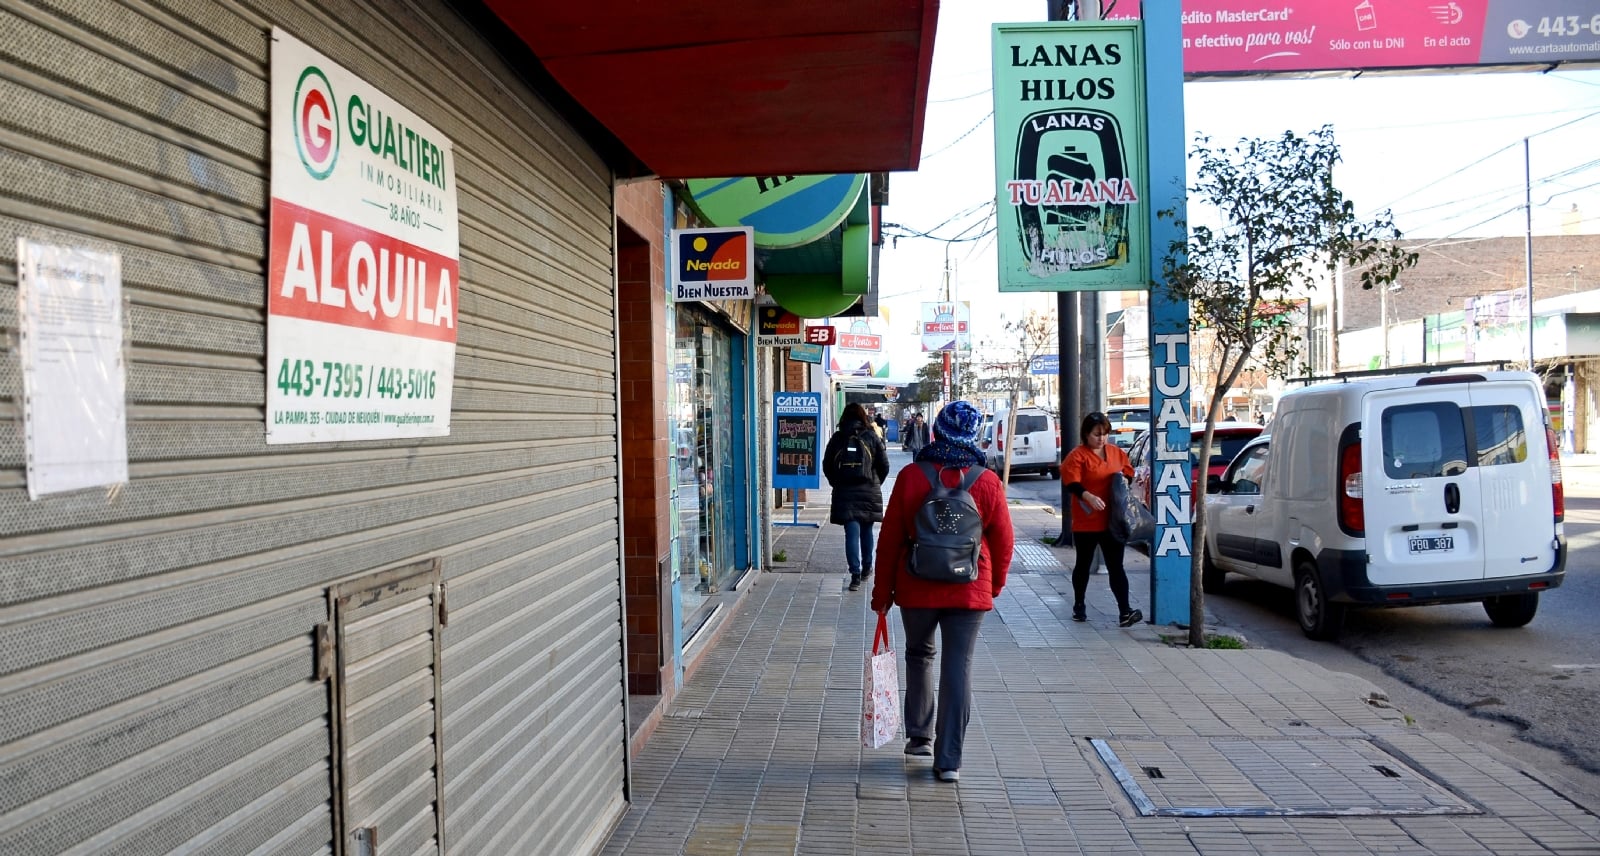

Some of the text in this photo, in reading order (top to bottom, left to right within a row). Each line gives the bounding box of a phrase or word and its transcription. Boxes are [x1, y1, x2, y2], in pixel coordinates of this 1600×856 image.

[1195, 34, 1243, 47] efectivo
[1245, 33, 1281, 52] para
[1284, 25, 1316, 45] vos!
[1329, 37, 1405, 50] Sólo con tu DNI
[1423, 36, 1471, 47] En el acto
[1010, 43, 1122, 67] LANAS
[1020, 77, 1115, 101] HILOS
[302, 89, 332, 163] G
[1032, 113, 1105, 132] LANAS
[347, 94, 446, 191] GUALTIERI
[360, 160, 444, 214] INMOBILIARIA
[1006, 178, 1138, 205] TUALANA
[389, 203, 421, 229] 38 AÑOS
[686, 259, 740, 272] Nevada
[1041, 247, 1108, 264] HILOS
[280, 221, 454, 330] ALQUILA
[763, 320, 795, 329] Nevada
[277, 358, 363, 398] 443-7395
[377, 366, 437, 399] 443-5016
[777, 396, 818, 406] CARTA
[275, 410, 284, 425] LA
[285, 411, 308, 425] PAMPA
[310, 411, 320, 425] 355
[325, 411, 347, 424] CIUDAD
[348, 411, 356, 424] DE
[1154, 333, 1191, 557] TUALANA
[1434, 538, 1452, 549] 387
